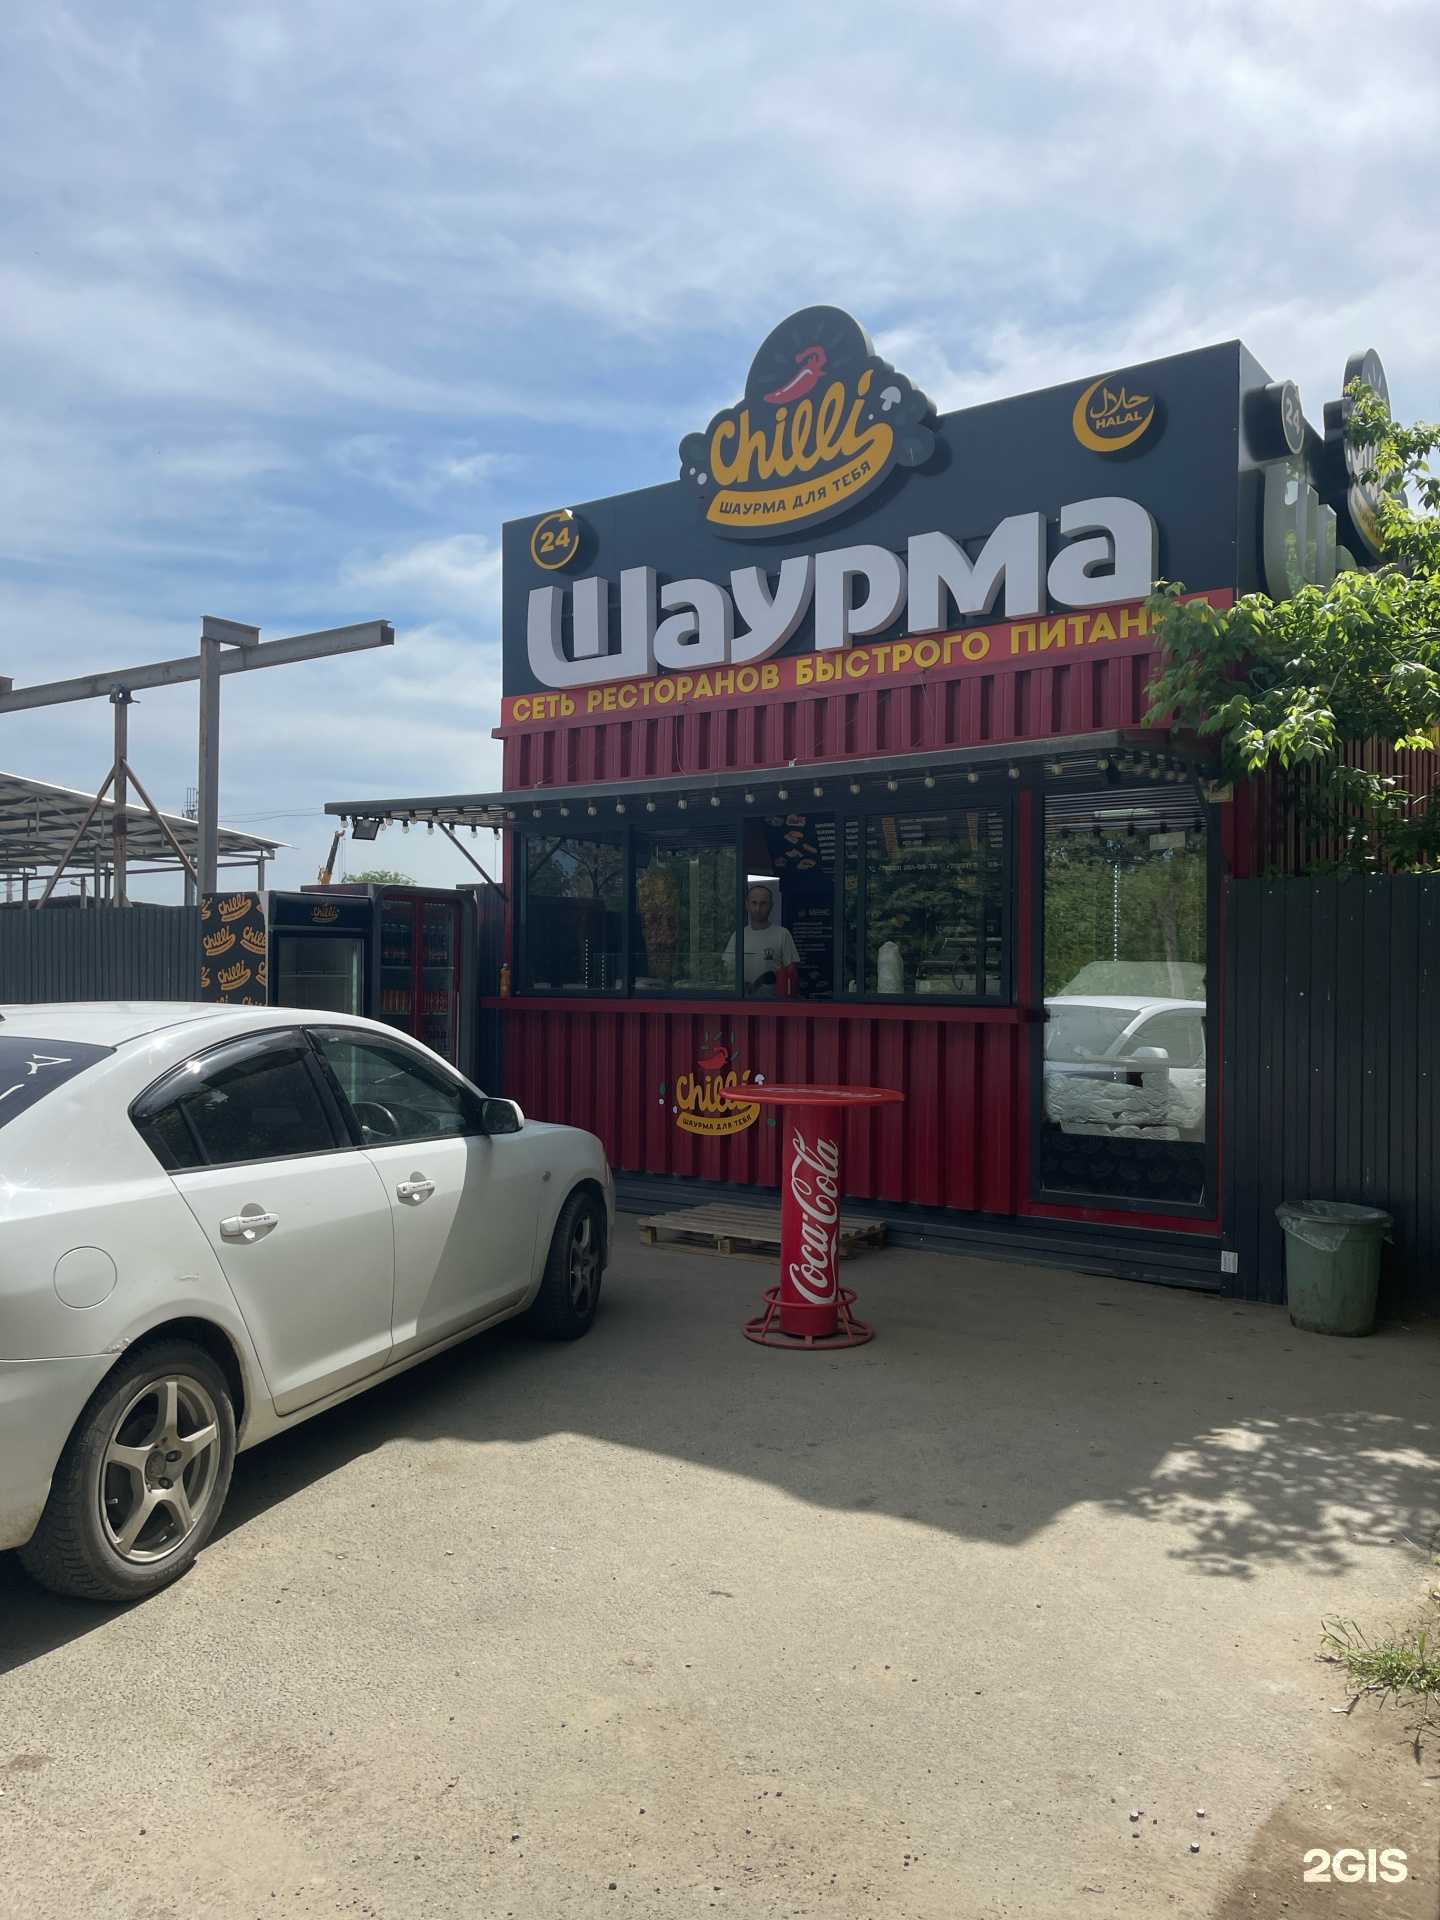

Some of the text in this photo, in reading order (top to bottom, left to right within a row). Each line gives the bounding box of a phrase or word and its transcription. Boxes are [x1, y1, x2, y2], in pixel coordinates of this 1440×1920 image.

[1089, 387, 1151, 418] حلال
[710, 369, 876, 486] Chilli
[1096, 411, 1143, 430] HALAL
[719, 460, 872, 516] ШАУРМА ДЛЯ ТЕБЯ
[541, 527, 570, 553] 24
[527, 496, 1159, 689] Шаурма
[511, 605, 1160, 722] СЕТЬ РЕСТОРАНОВ БЫСТРОГО ПИТАН
[218, 892, 247, 914] Chilli
[203, 926, 232, 949] Chilli
[218, 960, 247, 984] Chilli
[682, 1119, 714, 1130] ШАУРМА
